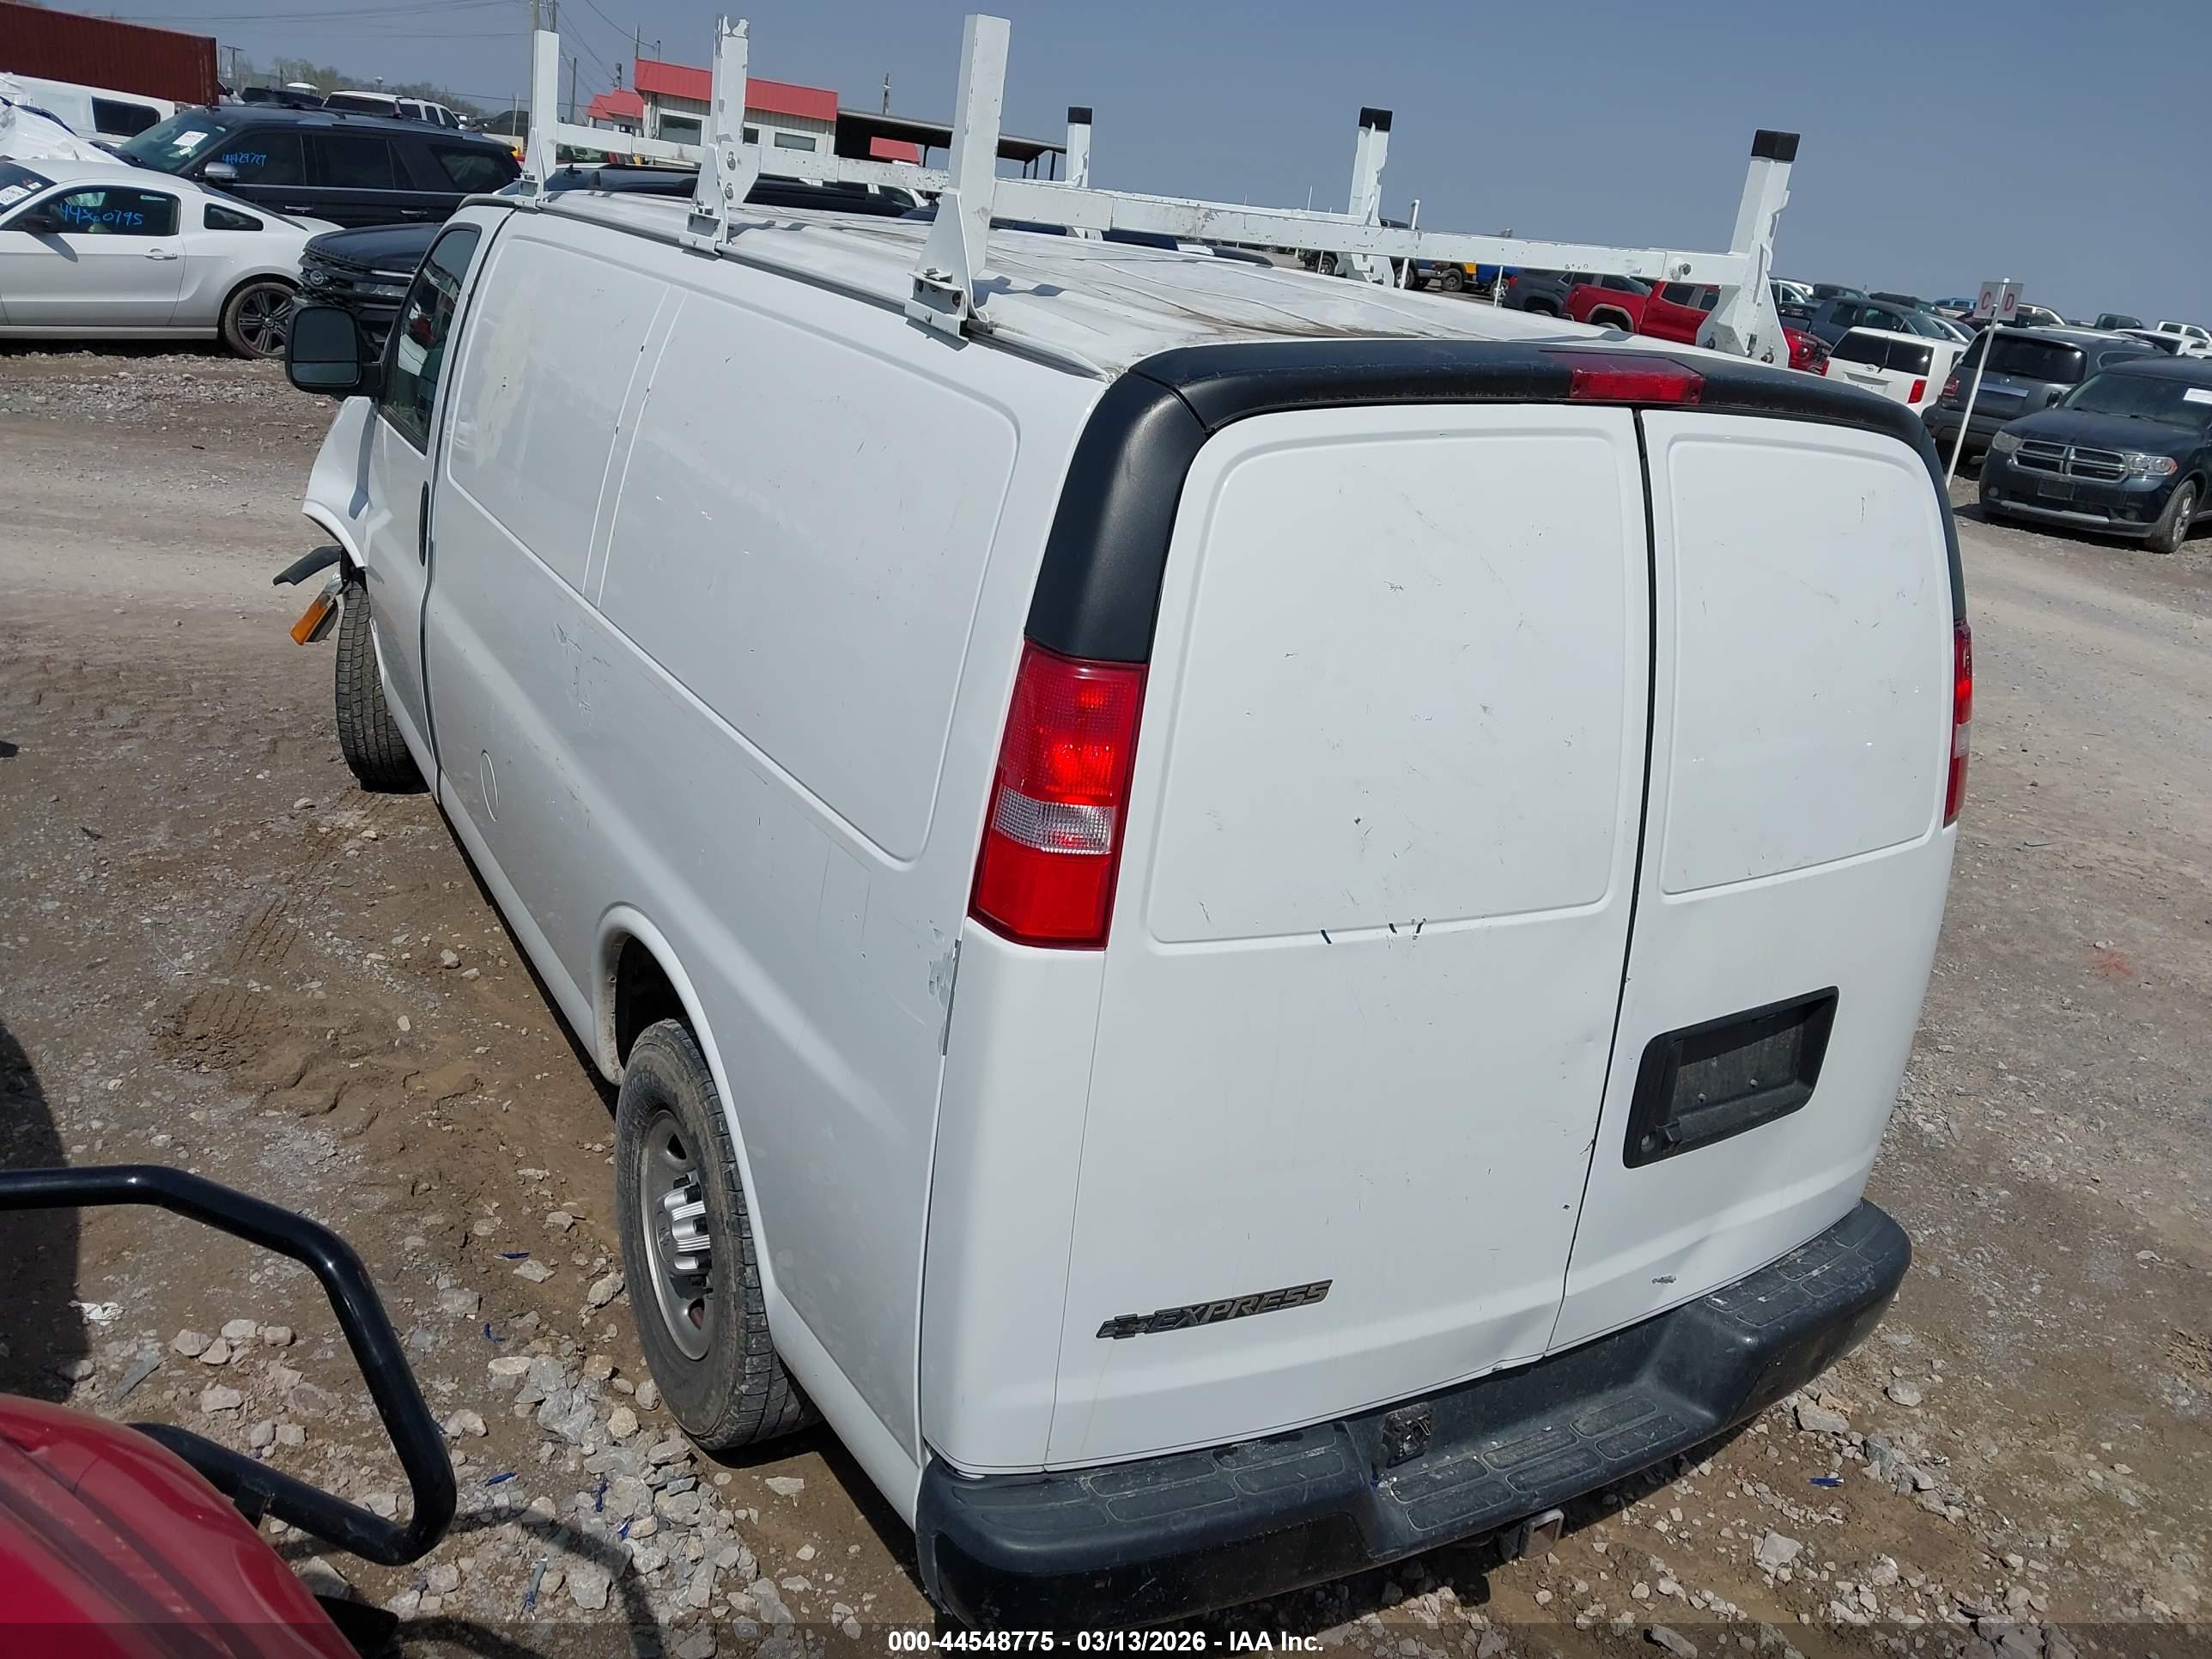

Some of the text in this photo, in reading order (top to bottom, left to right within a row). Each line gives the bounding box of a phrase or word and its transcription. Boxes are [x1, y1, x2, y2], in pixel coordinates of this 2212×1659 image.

[1981, 291, 1992, 310] C
[2004, 293, 2014, 312] D
[1151, 1280, 1333, 1330] EXPRESS
